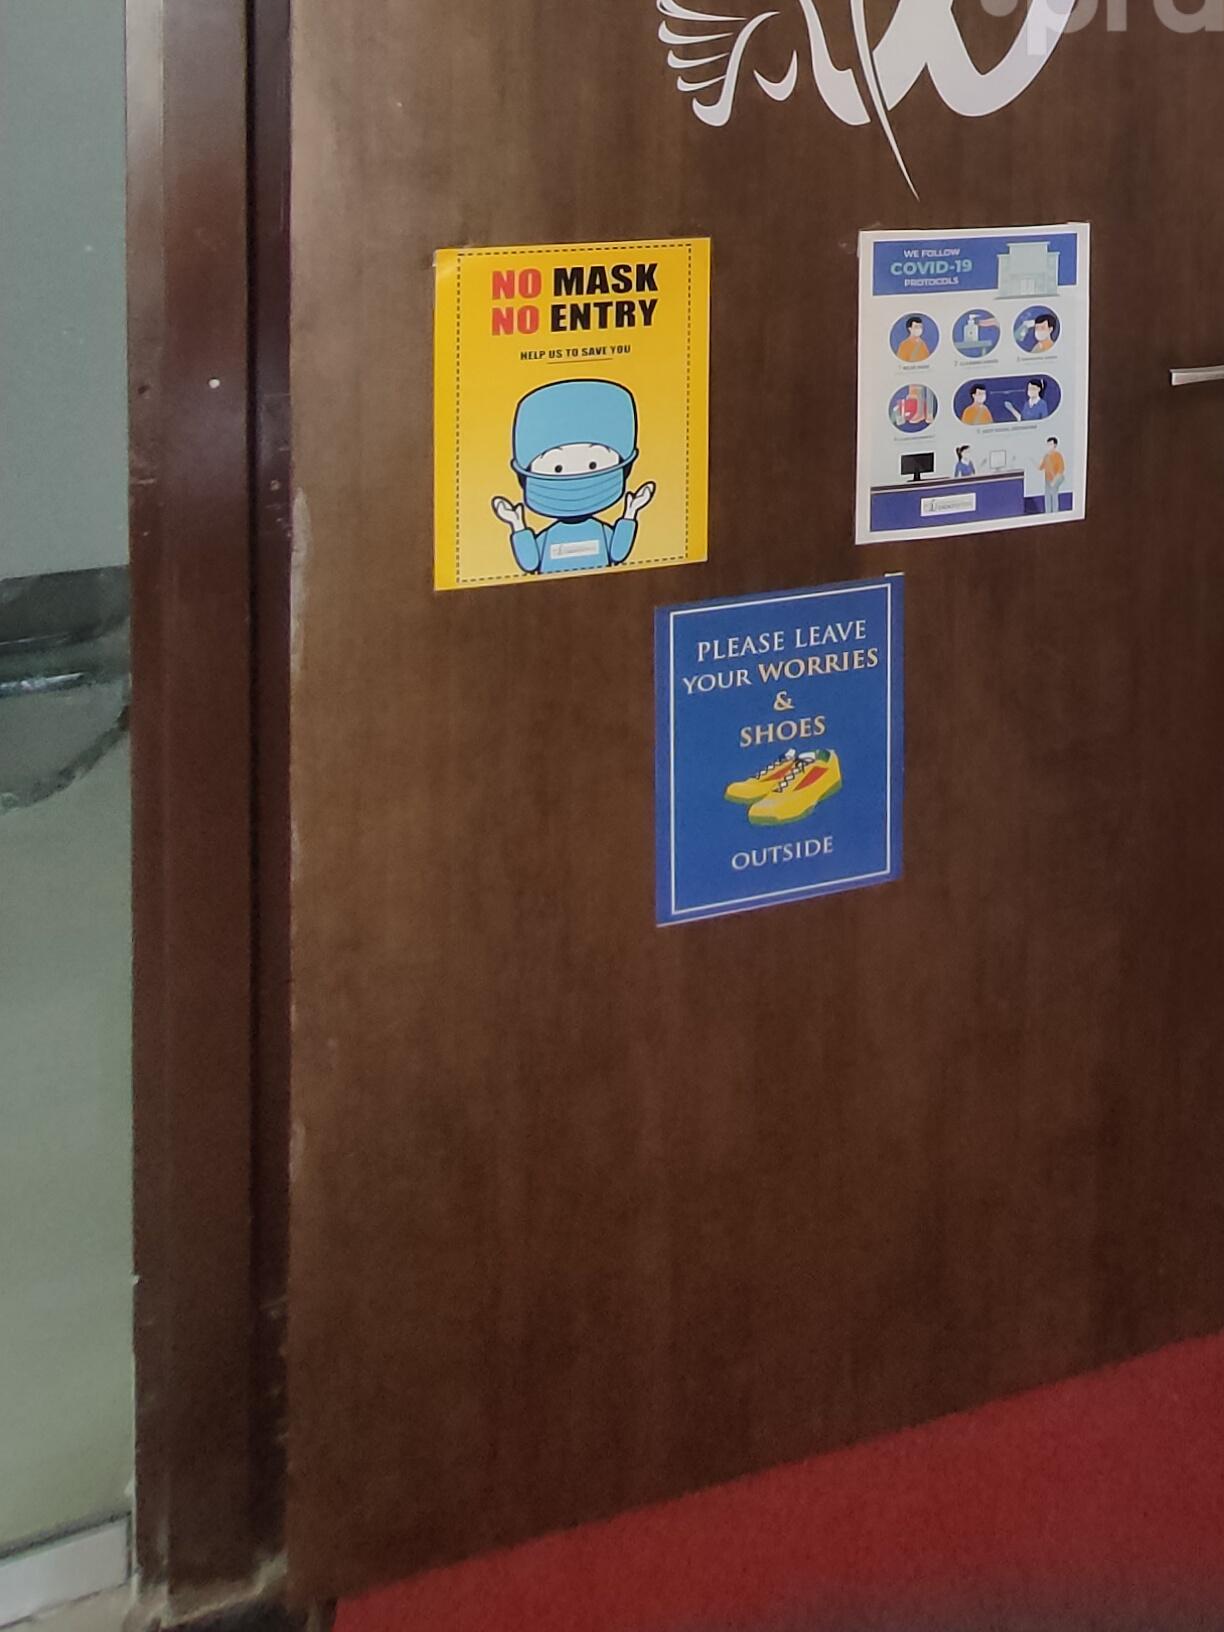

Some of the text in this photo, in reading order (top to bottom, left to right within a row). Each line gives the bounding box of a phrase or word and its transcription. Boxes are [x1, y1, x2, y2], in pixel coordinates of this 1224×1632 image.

[890, 258, 973, 276] COVID-19
[903, 248, 961, 258] WE FOLLOW
[491, 263, 658, 300] NO MASK
[904, 276, 959, 287] PROTOCOLS
[491, 298, 658, 336] NO ENTRY
[520, 344, 631, 360] HELP US TO SAVE YOU
[697, 620, 867, 662] PLEASE LEAVE
[682, 648, 879, 695] YOUR WORRIES
[773, 691, 795, 711] &
[739, 716, 827, 748] SHOES
[731, 836, 834, 870] OUTSIDE
